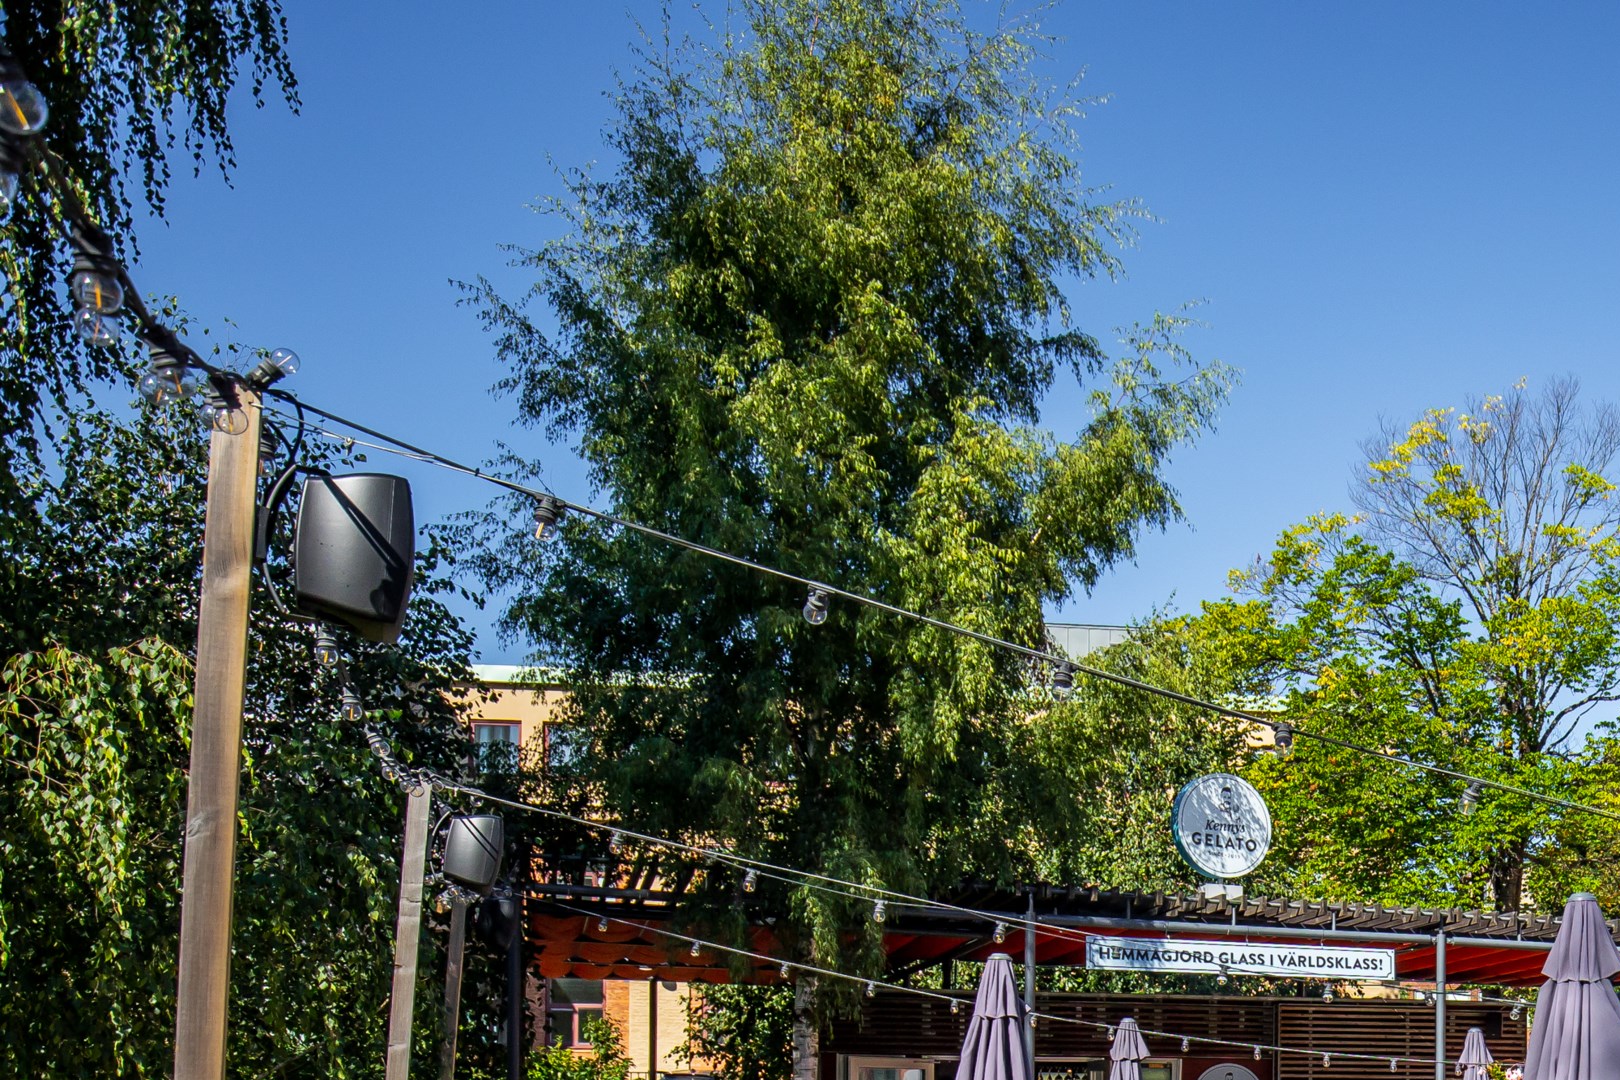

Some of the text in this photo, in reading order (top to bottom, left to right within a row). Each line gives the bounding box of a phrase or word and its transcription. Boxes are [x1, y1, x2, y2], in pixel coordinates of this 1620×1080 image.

[1205, 820, 1245, 834] Kennys
[1192, 832, 1257, 852] GELATO
[1100, 947, 1383, 970] HMMAGJORD GLASS I VÄRLDSKLASS!
